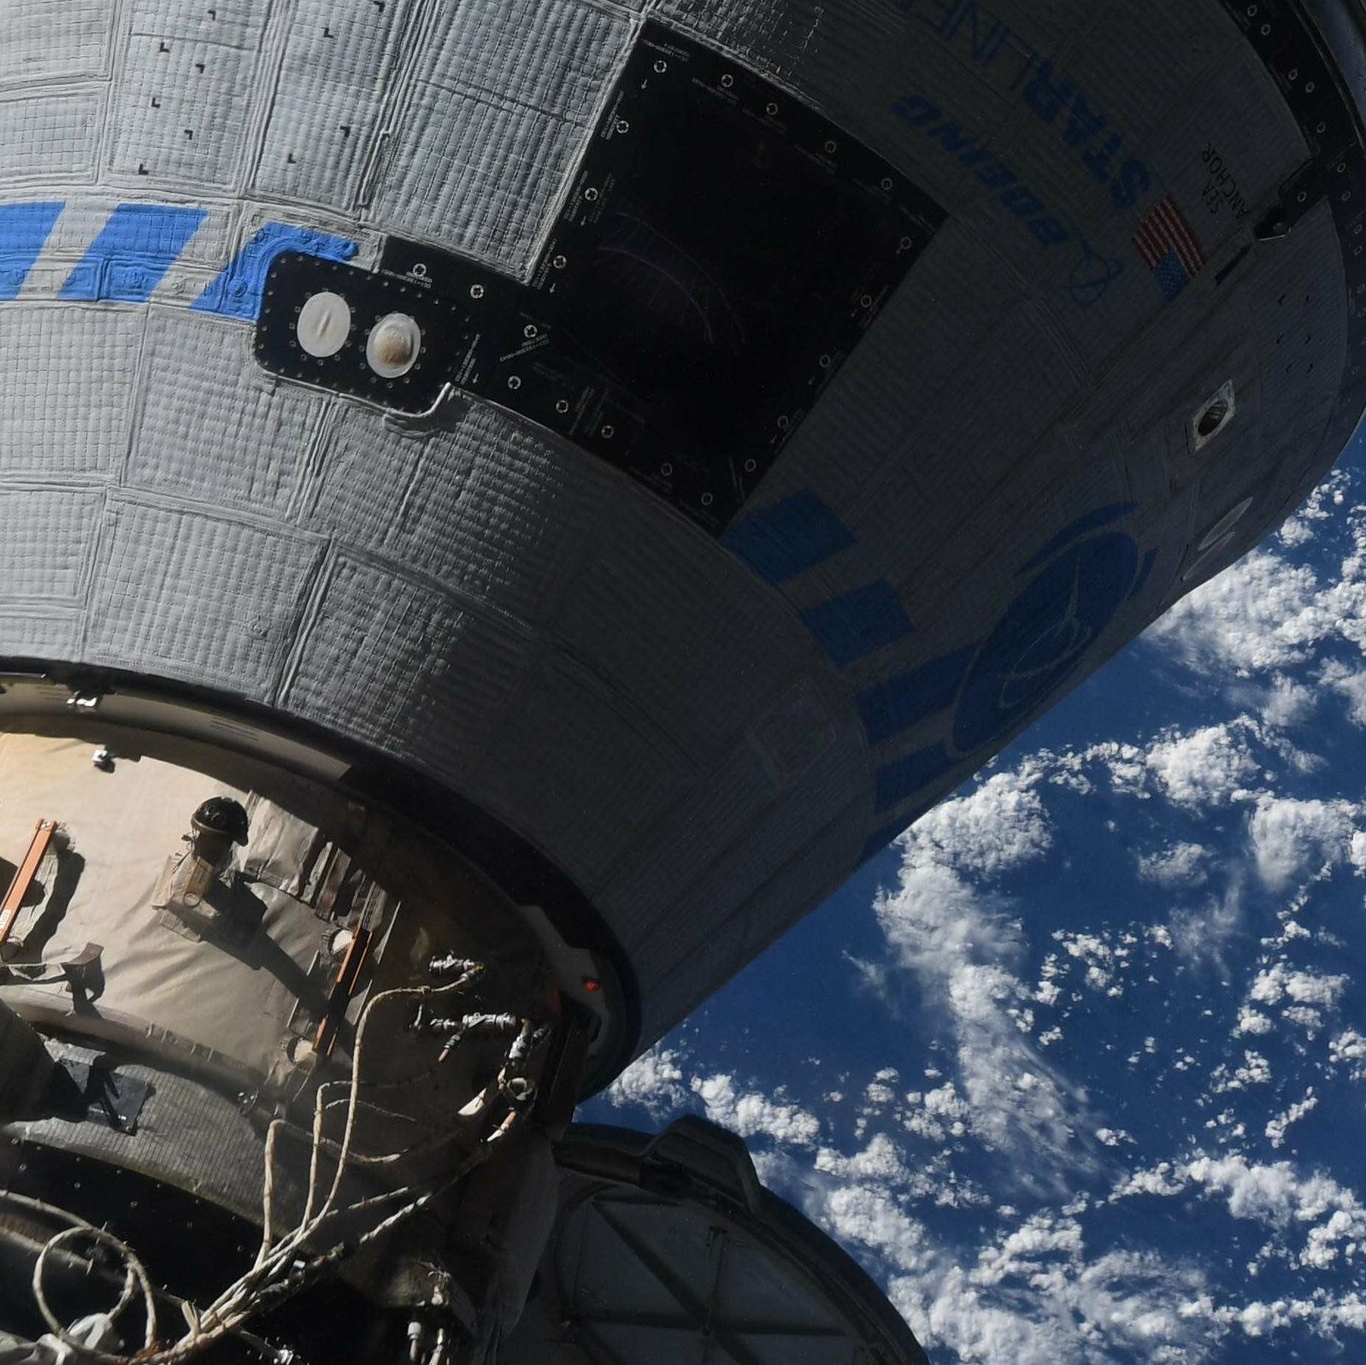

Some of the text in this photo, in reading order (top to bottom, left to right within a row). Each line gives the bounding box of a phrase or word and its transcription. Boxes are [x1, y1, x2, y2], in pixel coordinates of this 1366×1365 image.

[890, 94, 1069, 245] BOEING
[1201, 142, 1250, 220] ANCHOR
[1203, 180, 1223, 214] SEA
